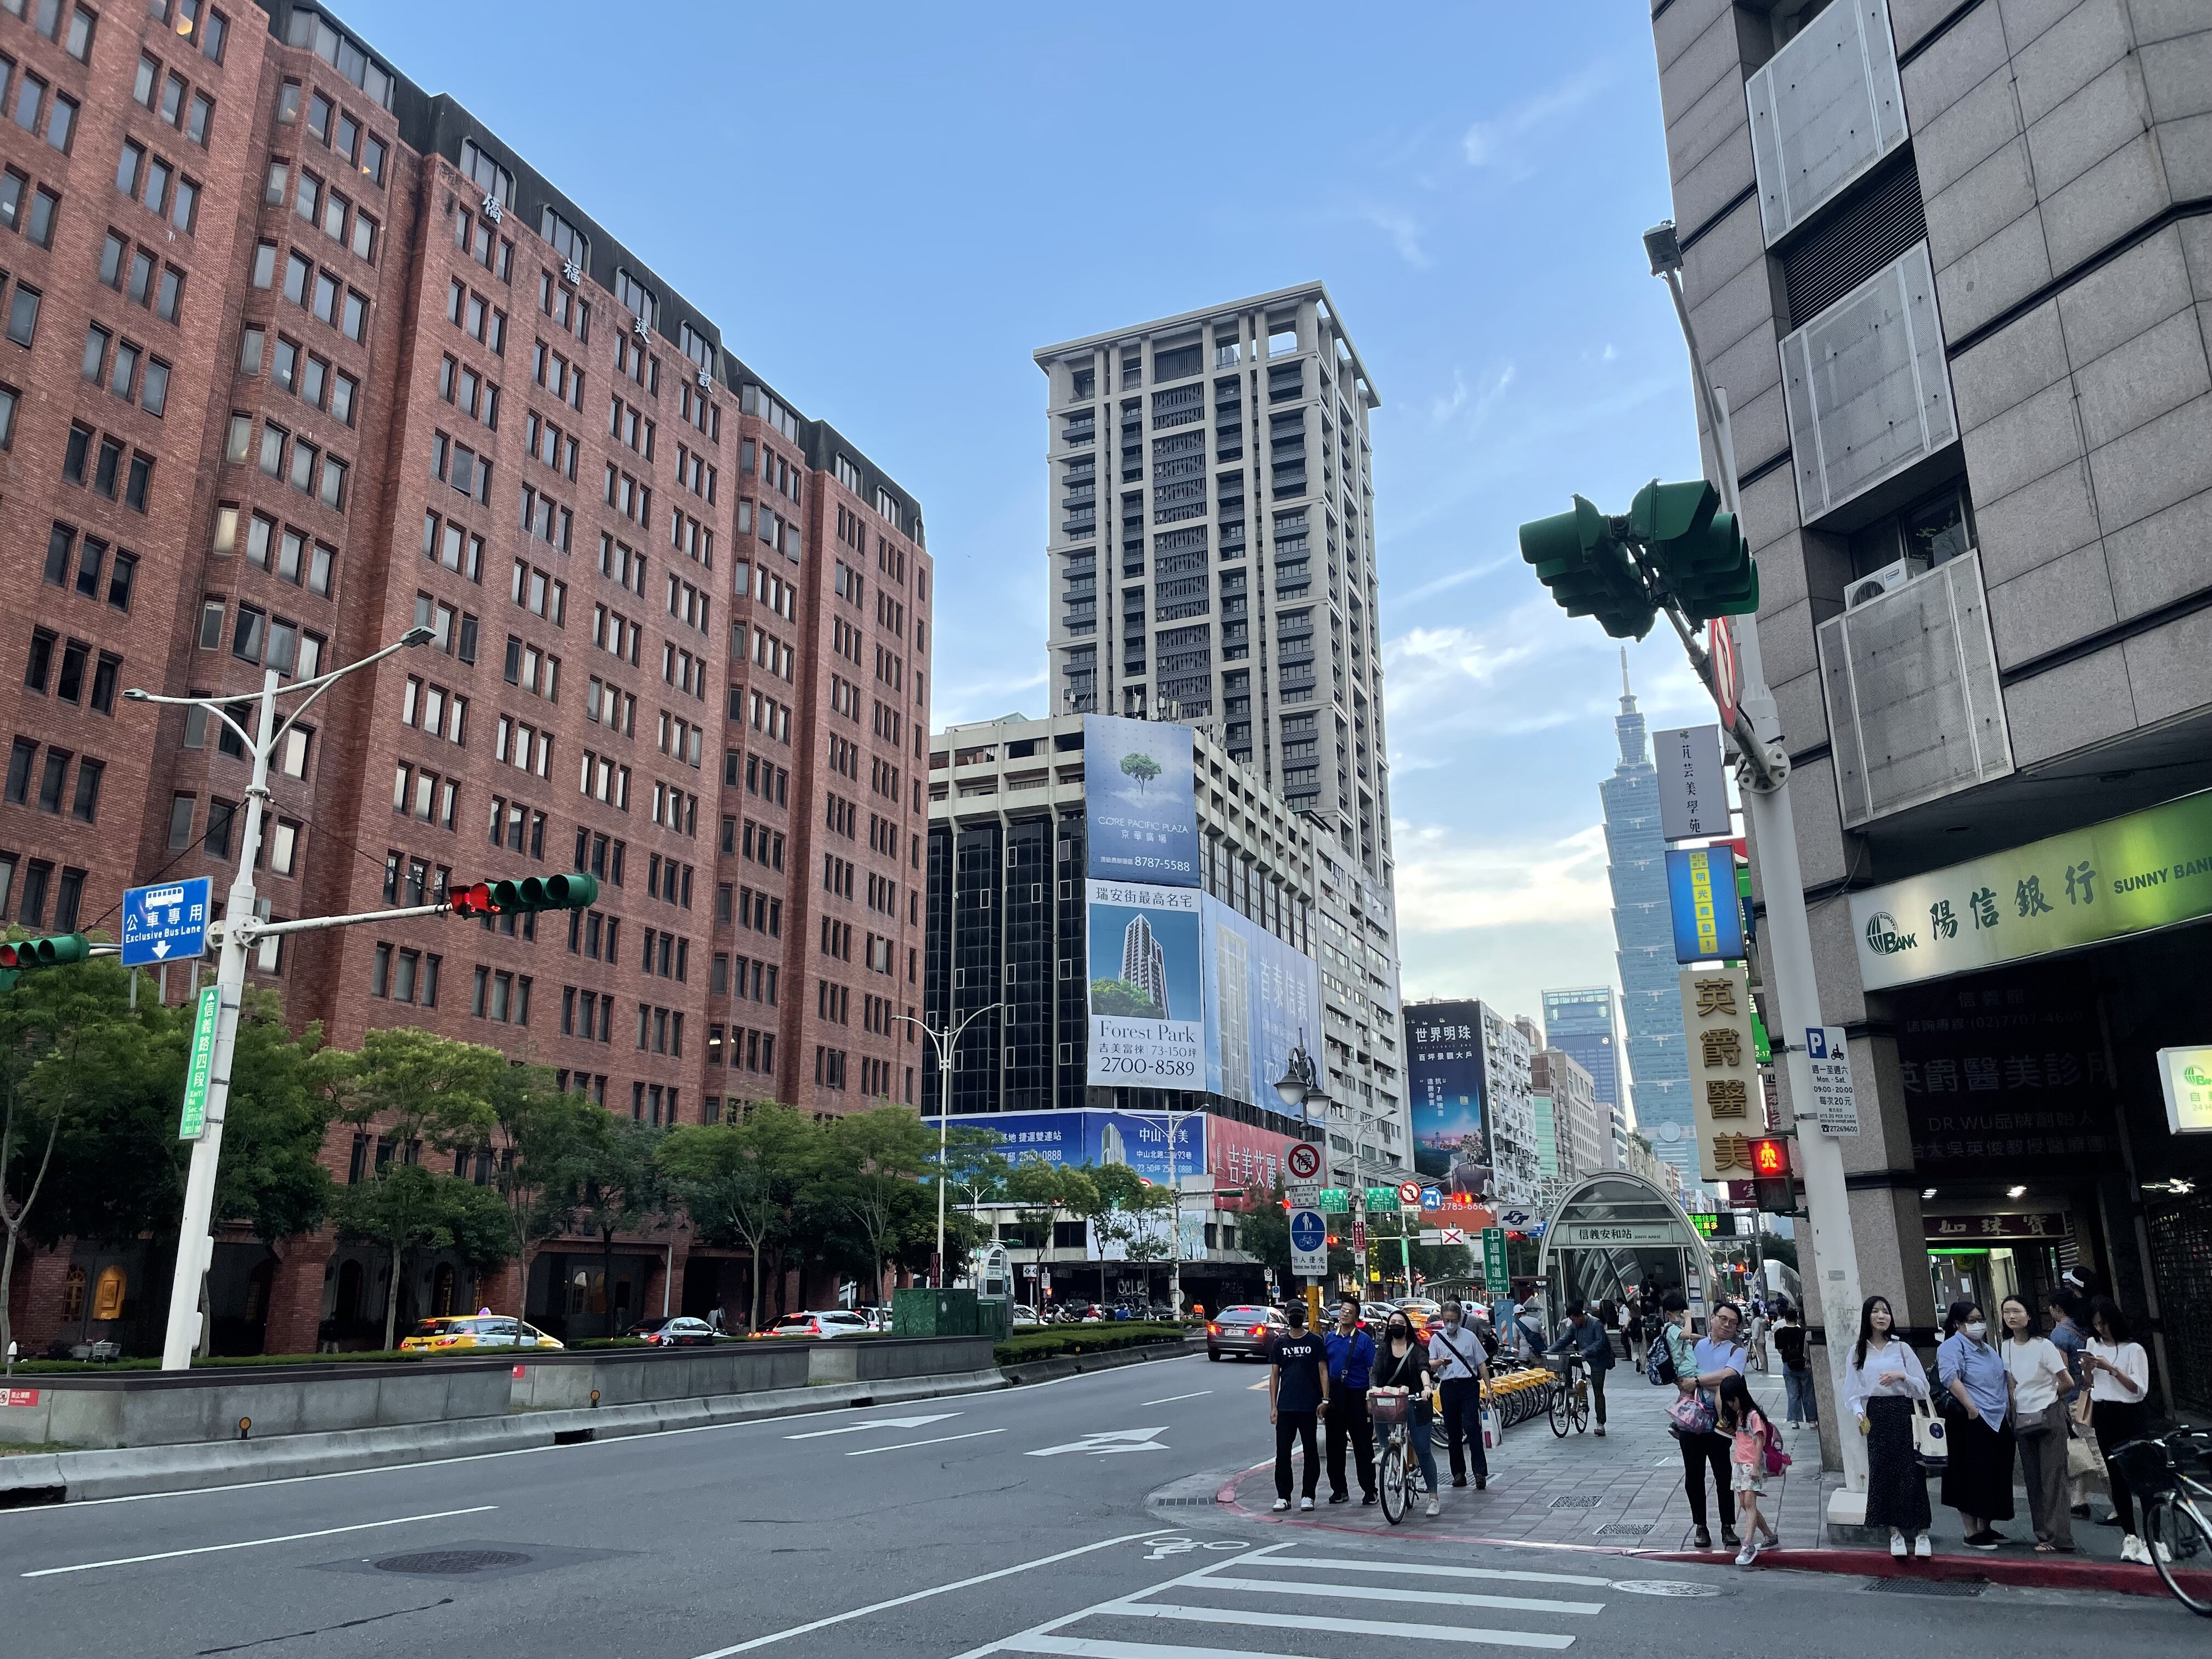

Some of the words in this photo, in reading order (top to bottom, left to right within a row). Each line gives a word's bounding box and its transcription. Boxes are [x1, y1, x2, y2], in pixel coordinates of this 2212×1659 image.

[1098, 816, 1125, 826] CORE
[1128, 819, 1160, 831] PACIFIC
[1162, 823, 1189, 834] PLAZA
[1121, 829, 1167, 844] 京華廣場
[1135, 856, 1190, 872] 8787-5588
[2114, 867, 2168, 894] SUNNY
[1096, 887, 1192, 908] 瑞安街最高名宅
[1930, 860, 2096, 941] 陽信銀行
[126, 904, 203, 932] 公車專用
[1880, 913, 1896, 927] SUNNY
[125, 929, 163, 944] Exclusive
[164, 927, 179, 938] Bus
[181, 924, 201, 935] Lane
[1259, 956, 1308, 1023] 首泰信義
[1099, 1020, 1153, 1040] Forest
[1158, 1024, 1195, 1043] Park
[1415, 1025, 1471, 1043] 世界明珠
[193, 1001, 215, 1088] 信義路四段
[1151, 1045, 1197, 1058] 73-150坪
[1809, 1032, 1822, 1054] P
[1418, 1051, 1472, 1062] 百坪景觀大戶
[1101, 1057, 1194, 1076] 2700-8589
[1694, 977, 1752, 1171] 英爵醫美
[1812, 1064, 1849, 1075] 週一至週六
[1819, 1096, 1852, 1106] 每次20元
[1018, 1131, 1062, 1143] 捷運雙連站
[1228, 1143, 1277, 1190] 吉美艾麗
[1296, 1153, 1312, 1171] 停
[1441, 1202, 1485, 1211] 2785-666
[1579, 1228, 1632, 1240] 信義安和站
[1293, 1256, 1325, 1264] 行人優先
[1489, 1242, 1502, 1278] 迴轉道
[1282, 1346, 1312, 1355] TOKYO
